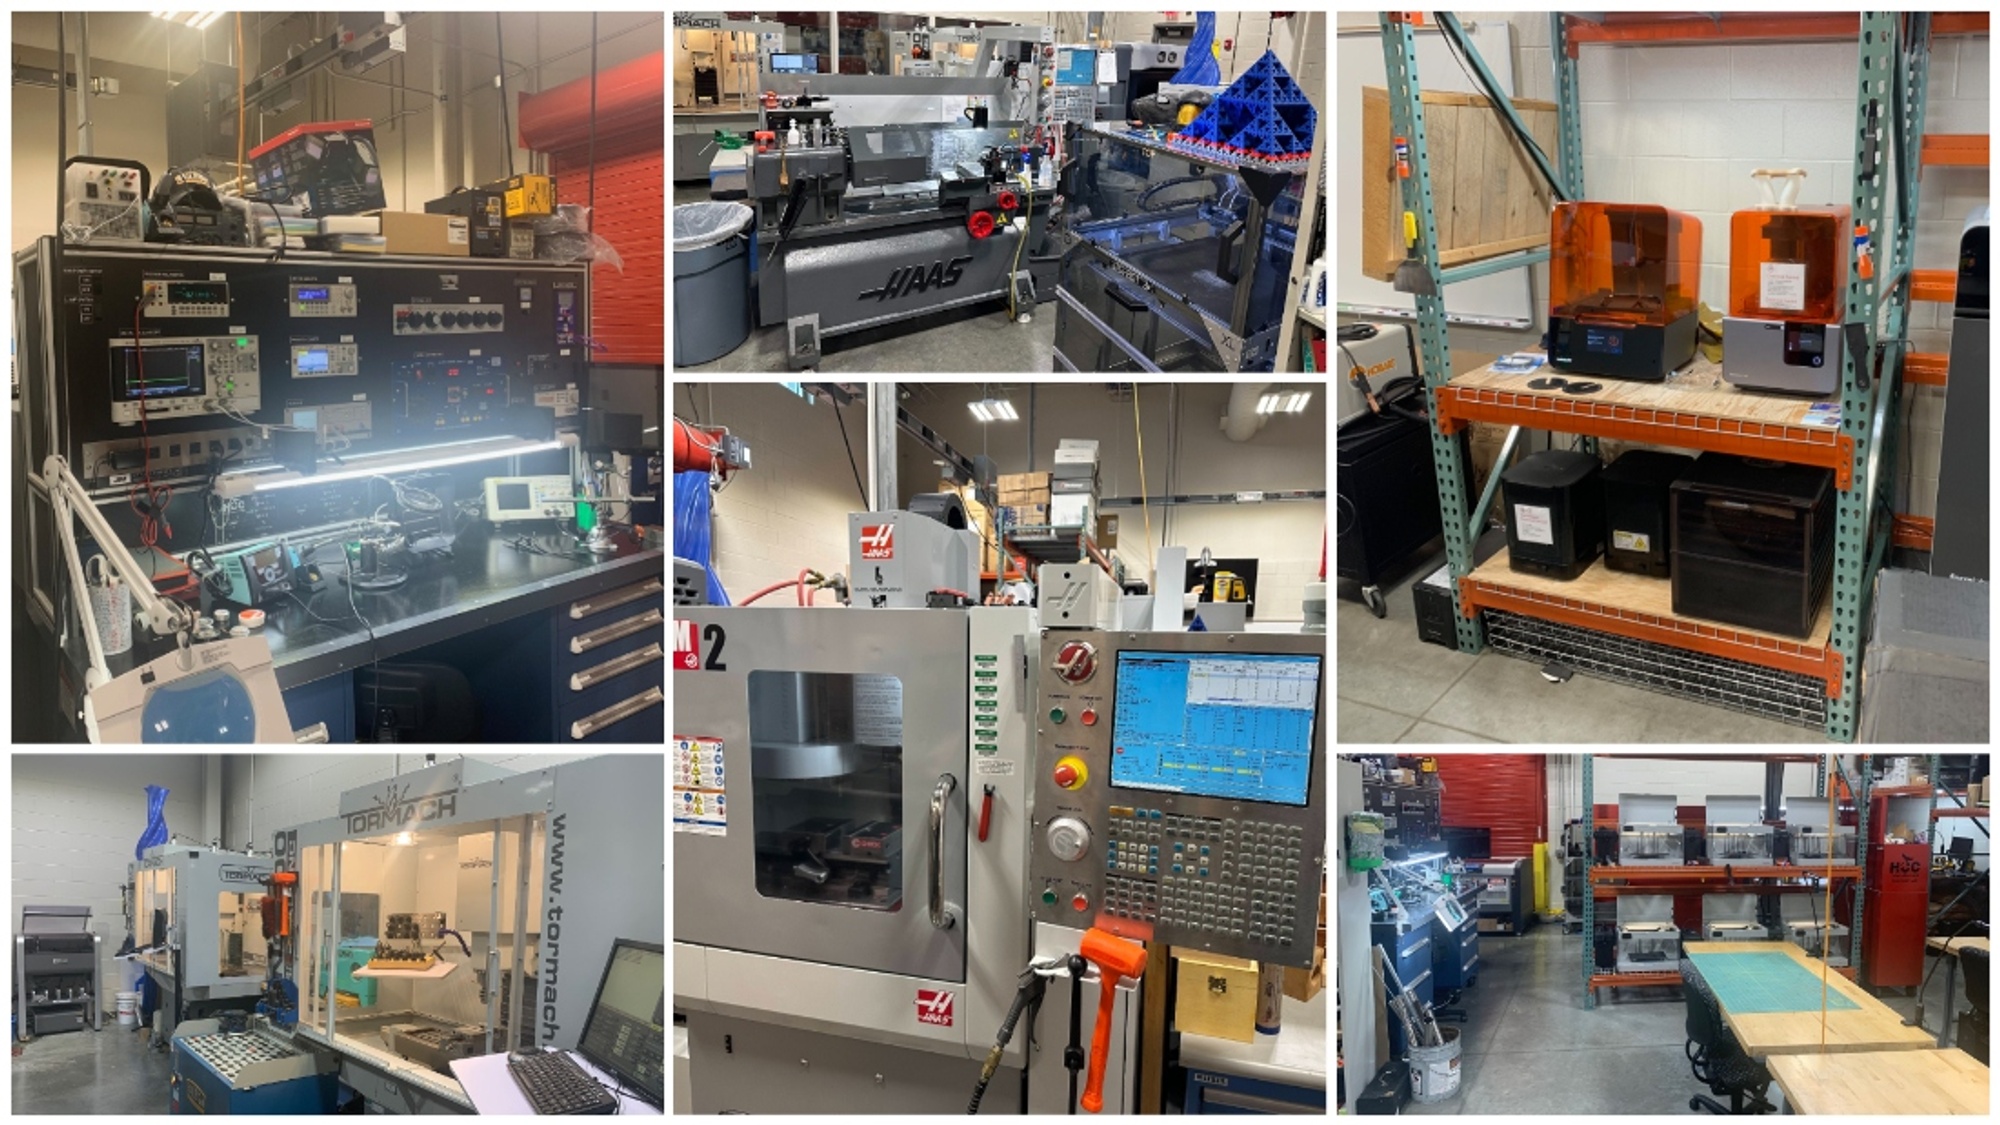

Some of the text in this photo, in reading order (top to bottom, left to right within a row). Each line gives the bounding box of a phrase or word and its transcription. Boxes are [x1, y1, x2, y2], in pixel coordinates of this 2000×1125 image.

[857, 255, 974, 301] HAAS
[703, 624, 726, 671] 2
[341, 794, 457, 834] TORMACH
[1890, 862, 1920, 874] HCC
